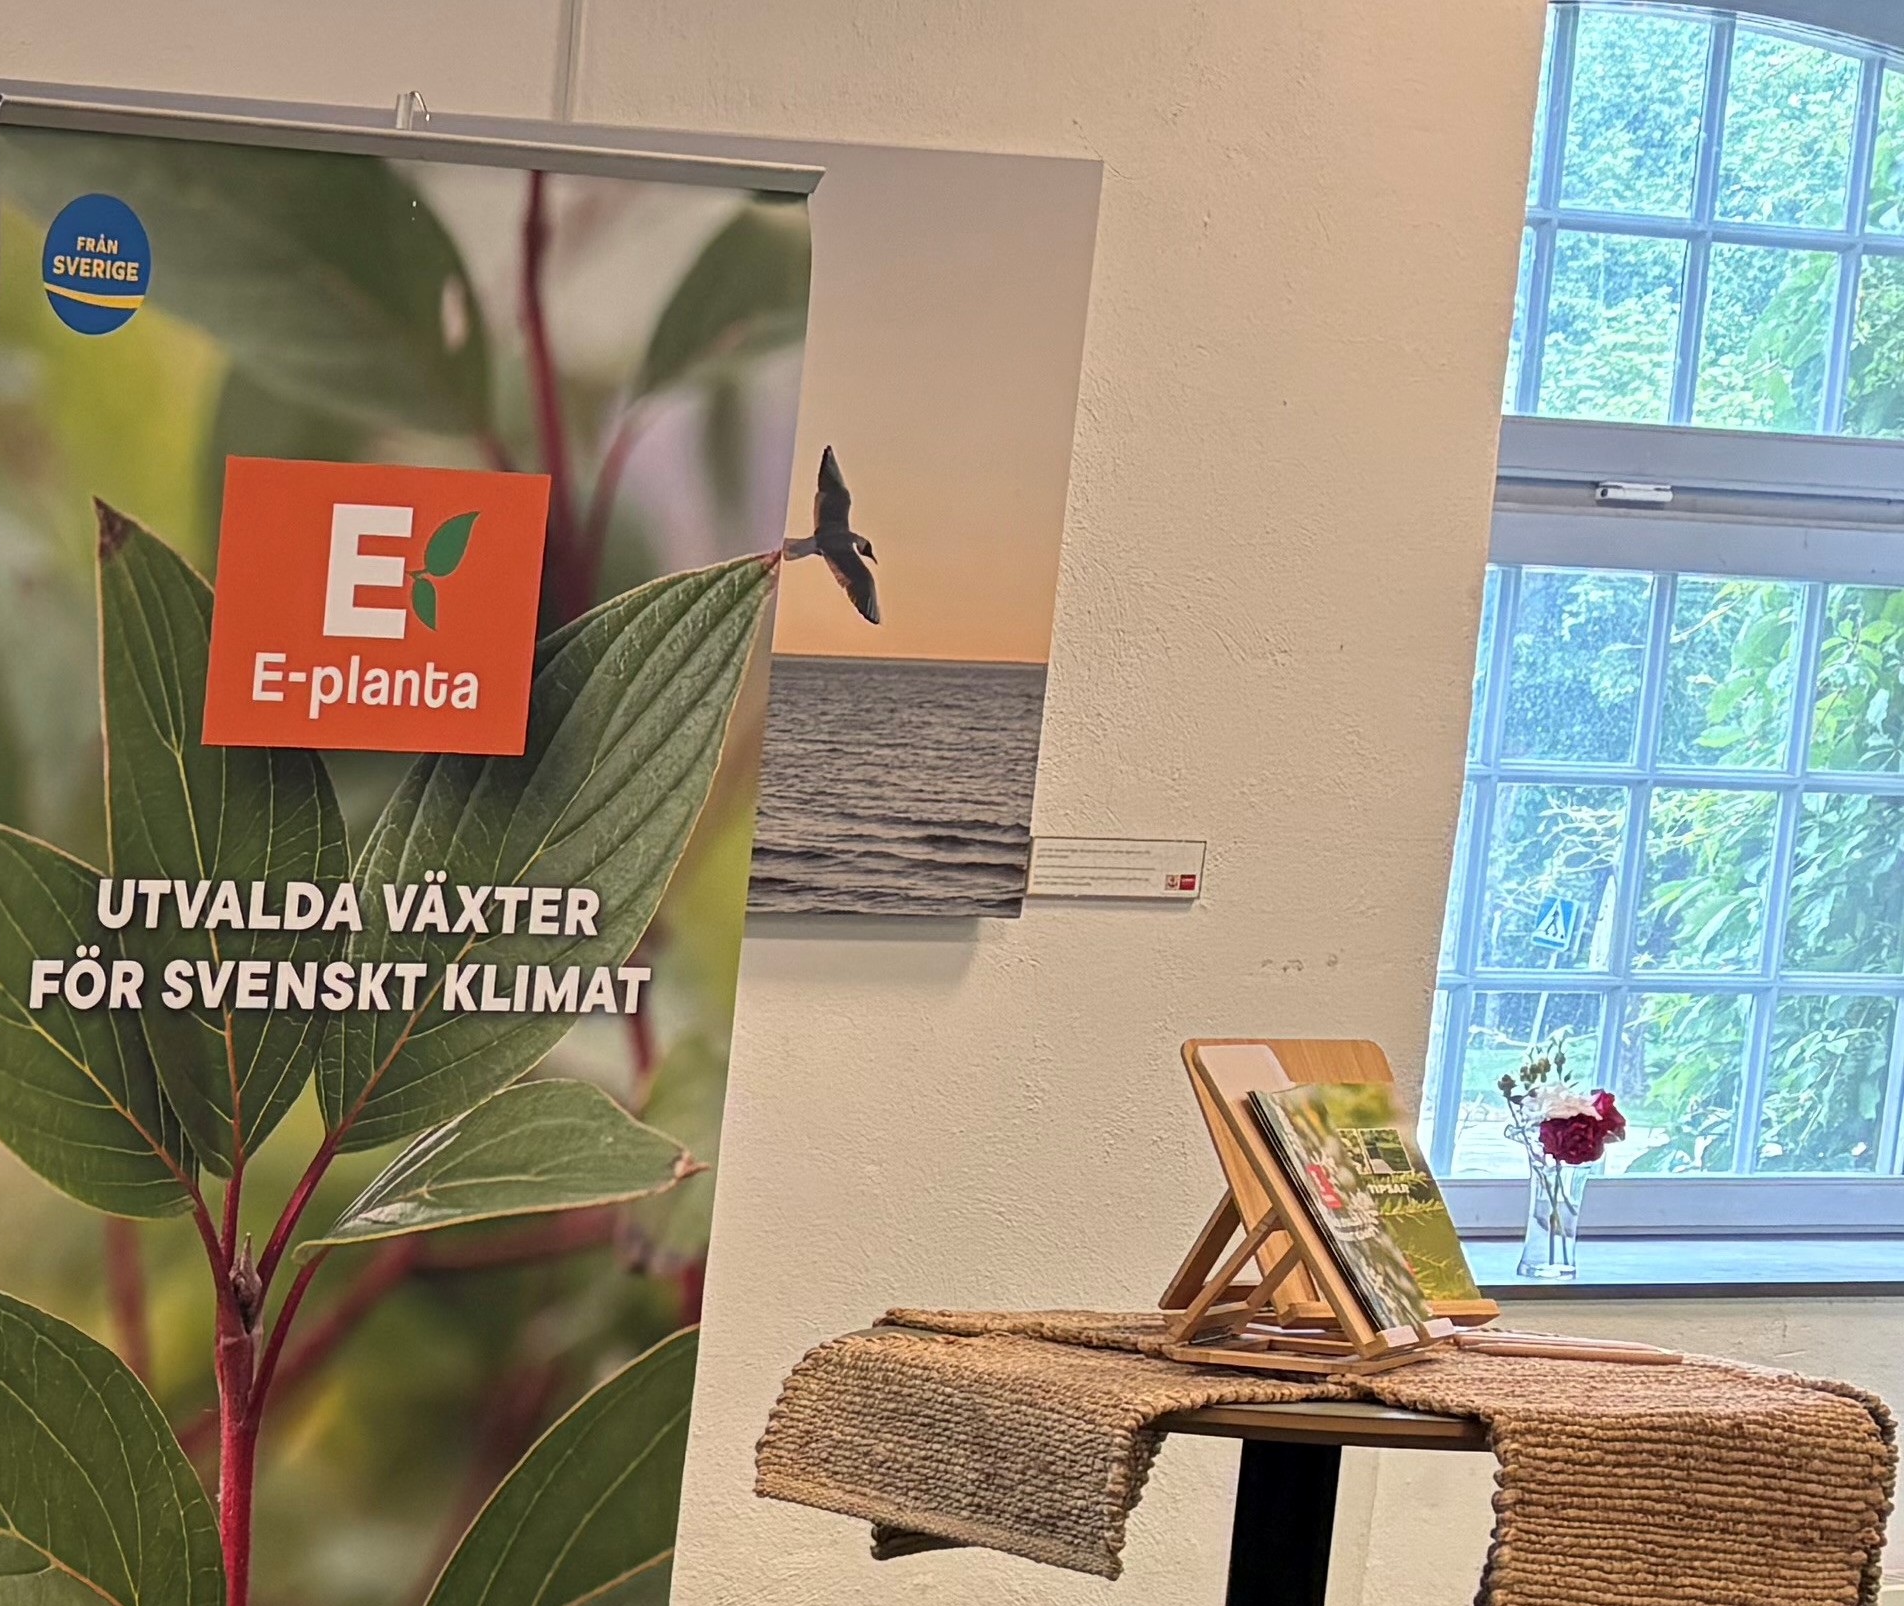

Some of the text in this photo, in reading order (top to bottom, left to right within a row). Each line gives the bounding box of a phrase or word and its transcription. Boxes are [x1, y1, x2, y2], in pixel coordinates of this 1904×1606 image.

[52, 254, 140, 282] SVERIGE
[76, 233, 119, 255] FRÅN
[322, 503, 414, 640] E
[252, 652, 479, 720] E-planta
[97, 870, 600, 936] UTVALDA VÄXTER
[29, 944, 652, 1014] FÖR SVENSKT KLIMAT
